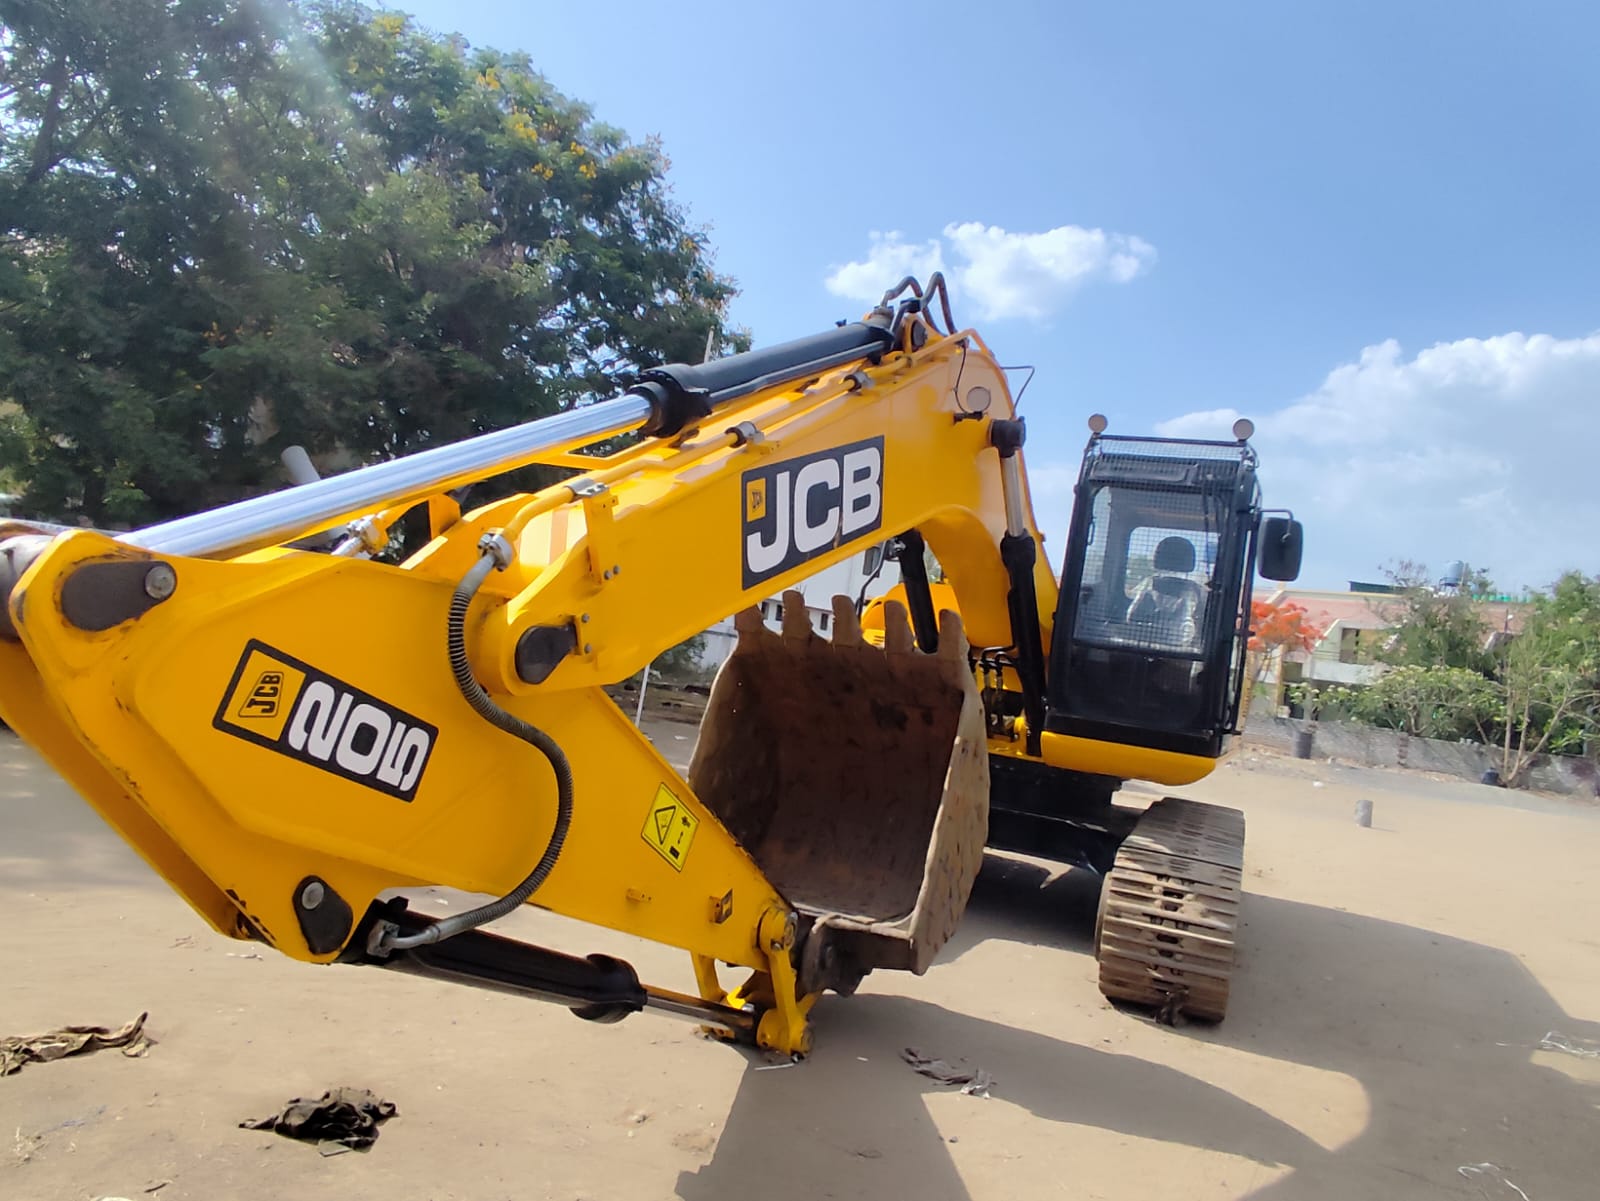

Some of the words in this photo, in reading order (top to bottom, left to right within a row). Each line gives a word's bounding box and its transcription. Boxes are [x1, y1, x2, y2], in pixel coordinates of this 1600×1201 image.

[747, 447, 880, 573] JCB
[246, 674, 281, 713] JCB
[288, 680, 430, 792] 205
